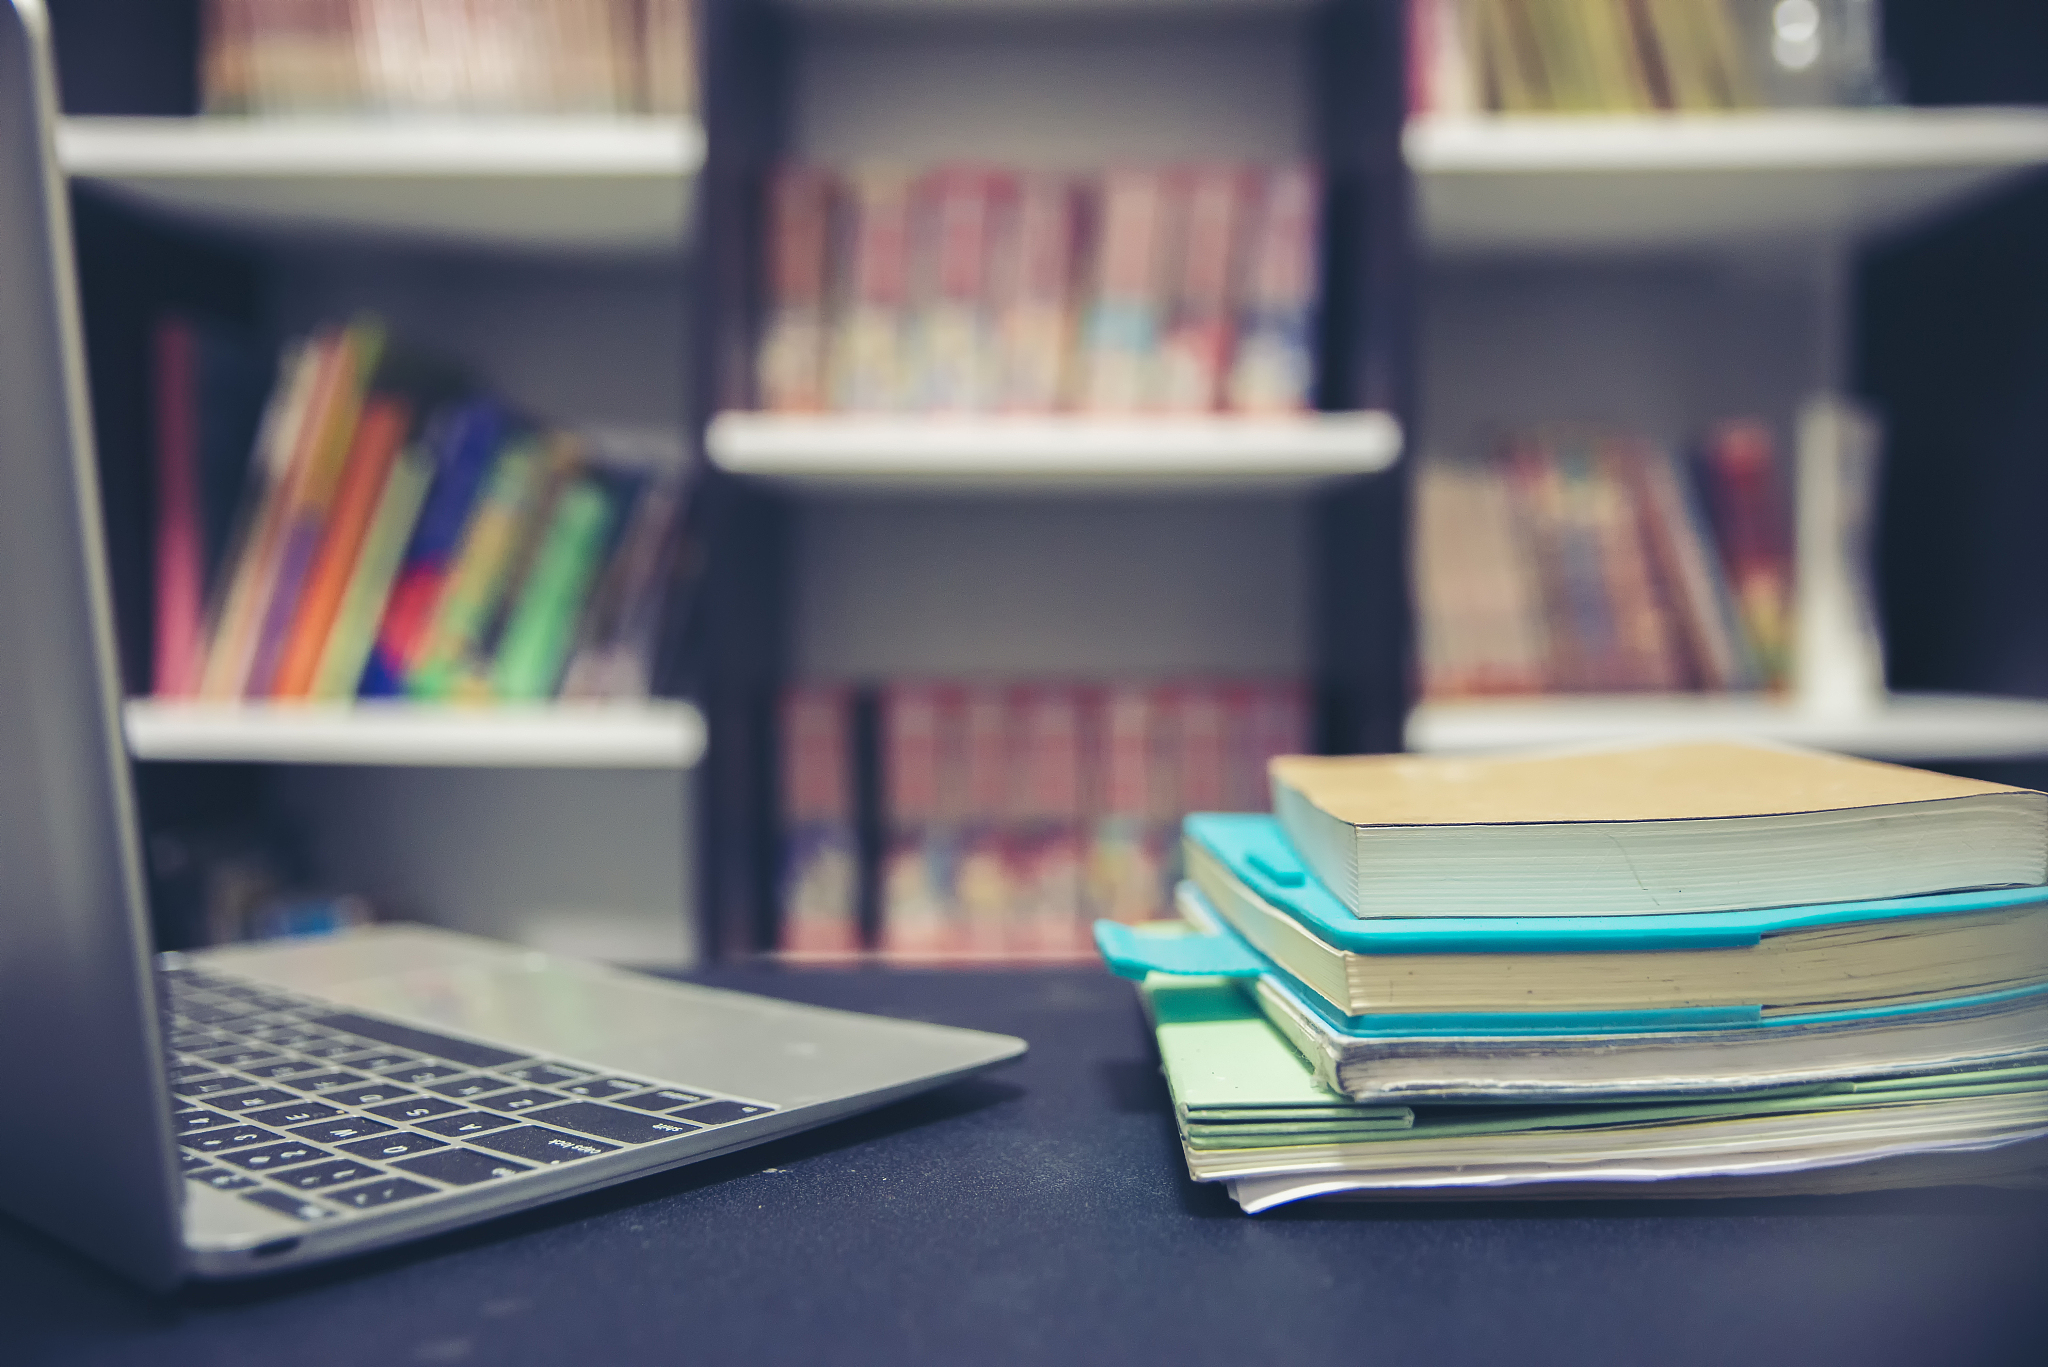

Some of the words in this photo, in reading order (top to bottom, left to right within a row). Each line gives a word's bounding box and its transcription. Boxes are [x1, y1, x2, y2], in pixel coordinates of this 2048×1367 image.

[285, 1112, 310, 1121] E
[405, 1107, 430, 1117] S
[459, 1123, 482, 1131] A
[330, 1128, 358, 1138] W
